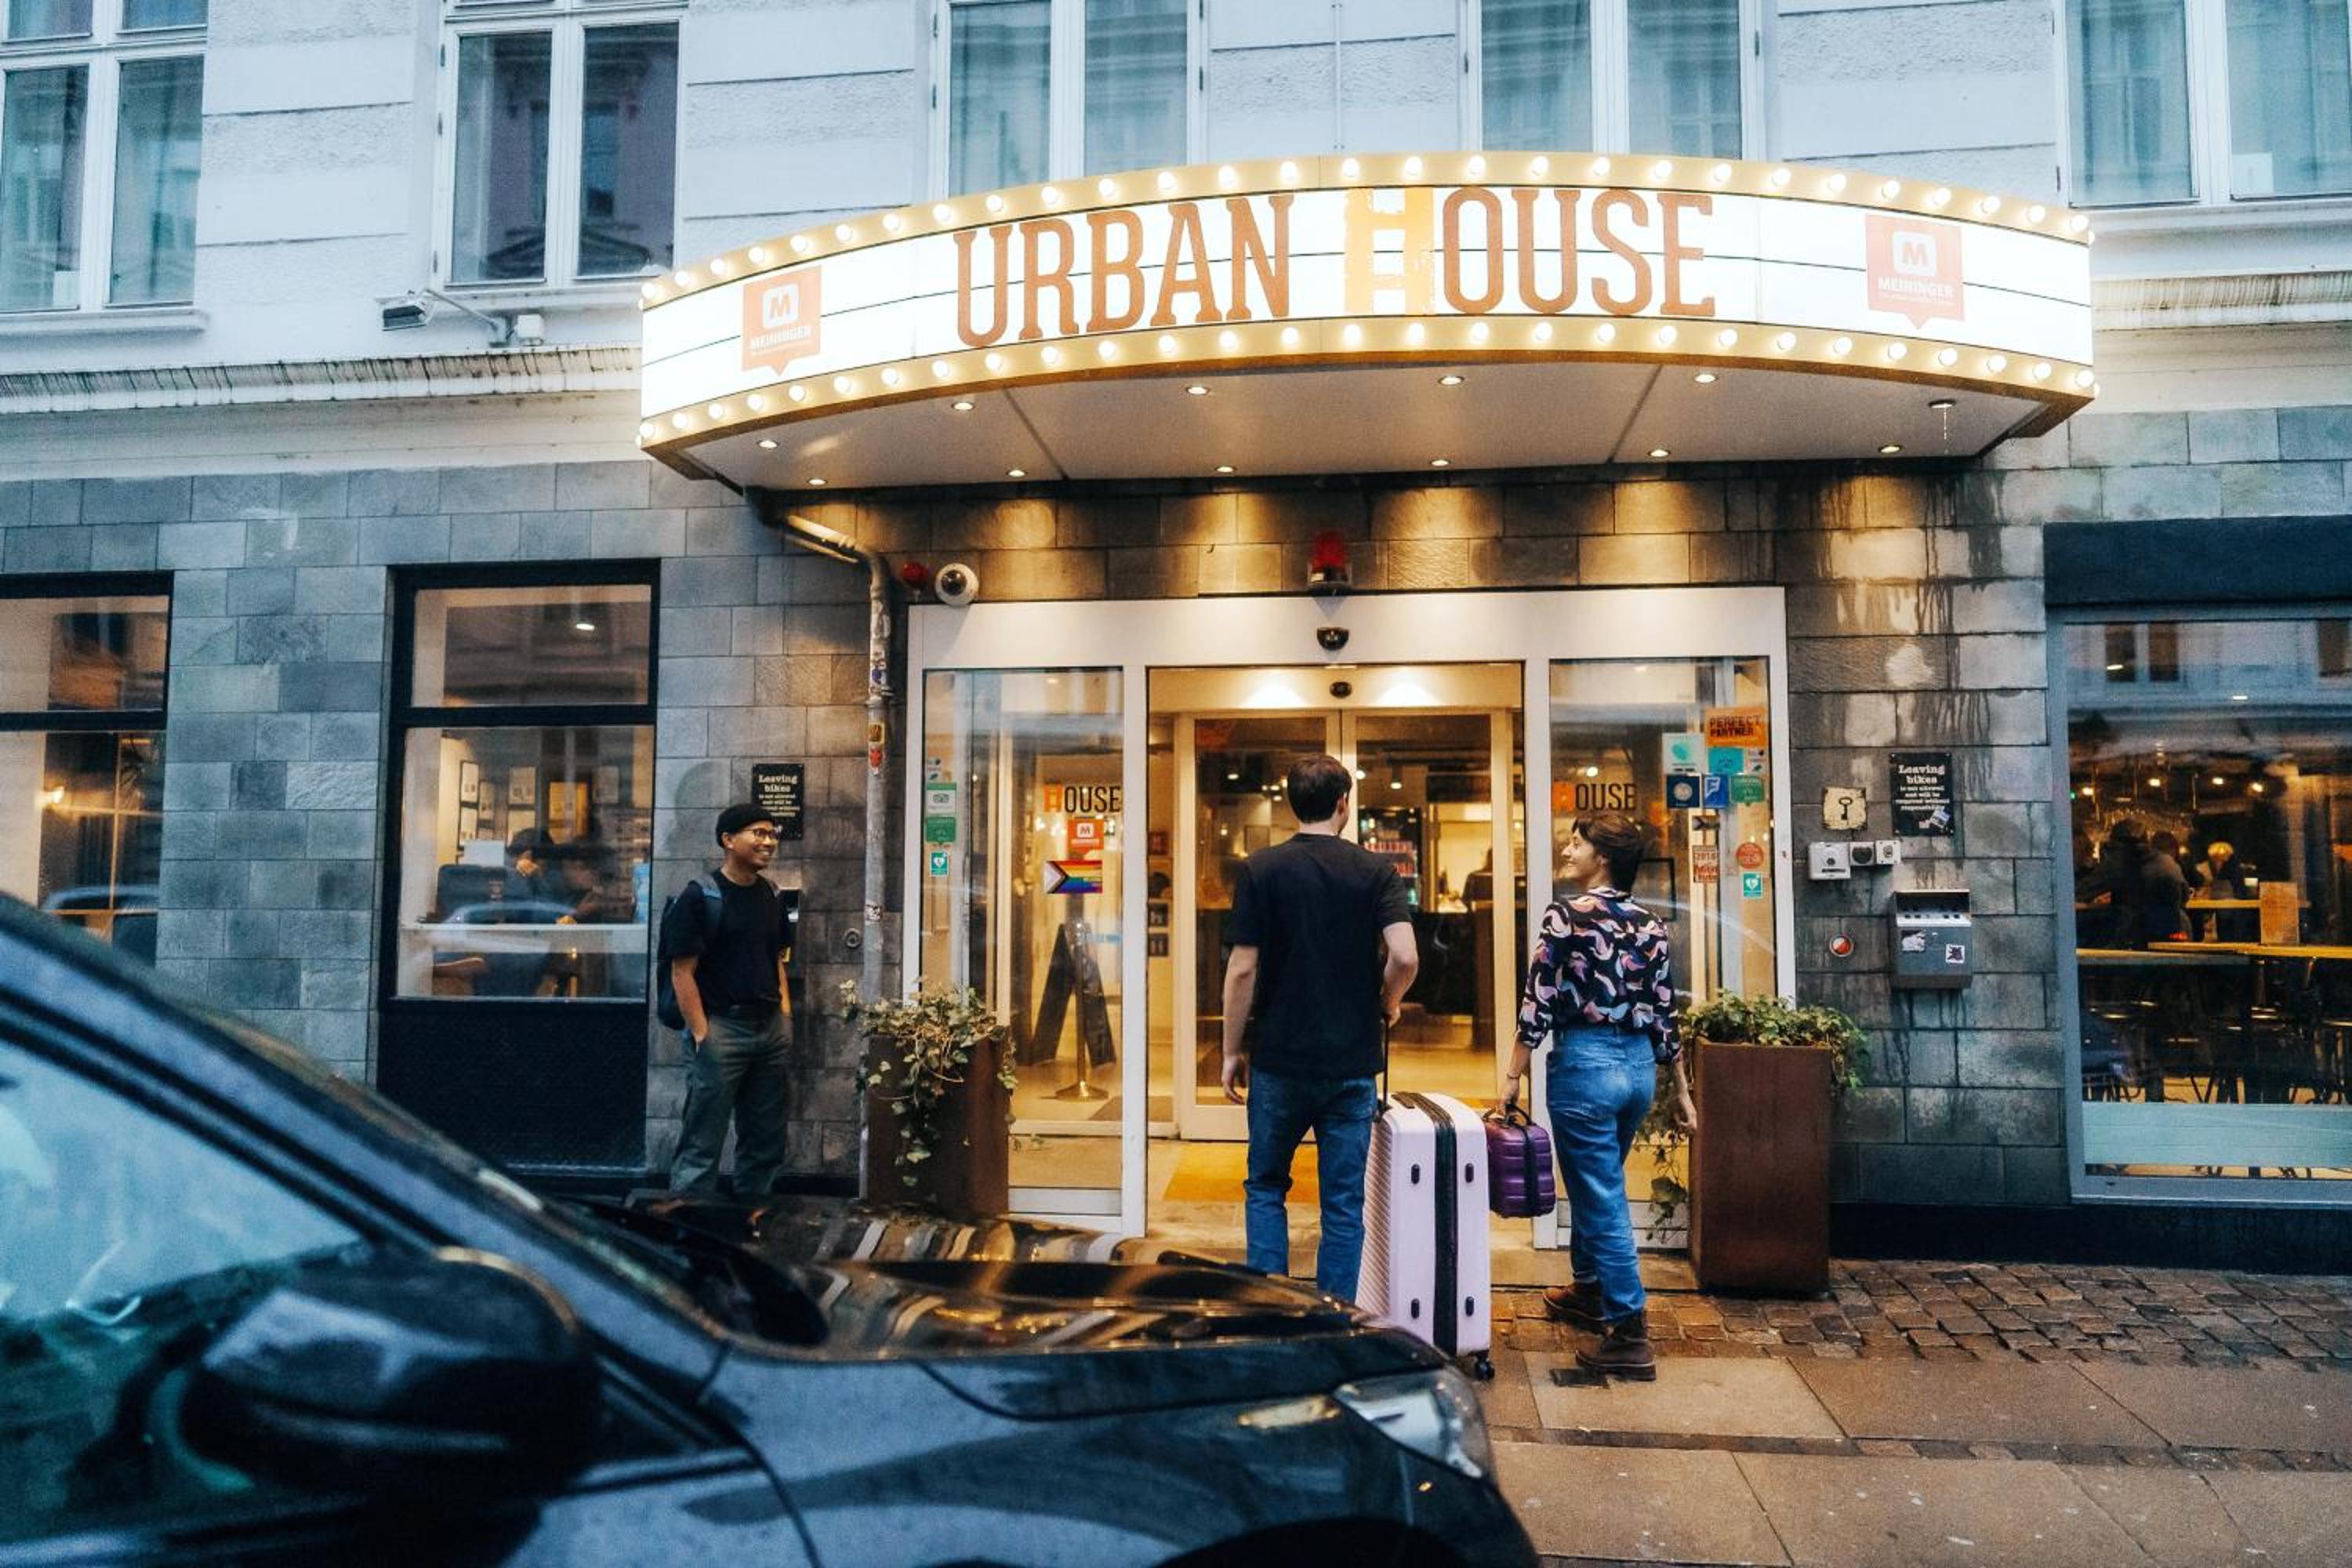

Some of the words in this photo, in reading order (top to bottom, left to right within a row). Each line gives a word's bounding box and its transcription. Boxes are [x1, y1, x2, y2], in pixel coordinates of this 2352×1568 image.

[953, 194, 1295, 347] URBAN
[1344, 187, 1715, 318] HOUSE
[1877, 275, 1954, 301] MEININGER
[750, 325, 811, 352] MEININGER
[1709, 714, 1761, 728] PERFECT
[1898, 764, 1945, 775] Leaving
[758, 774, 797, 784] Leaving
[1906, 775, 1938, 784] bikes
